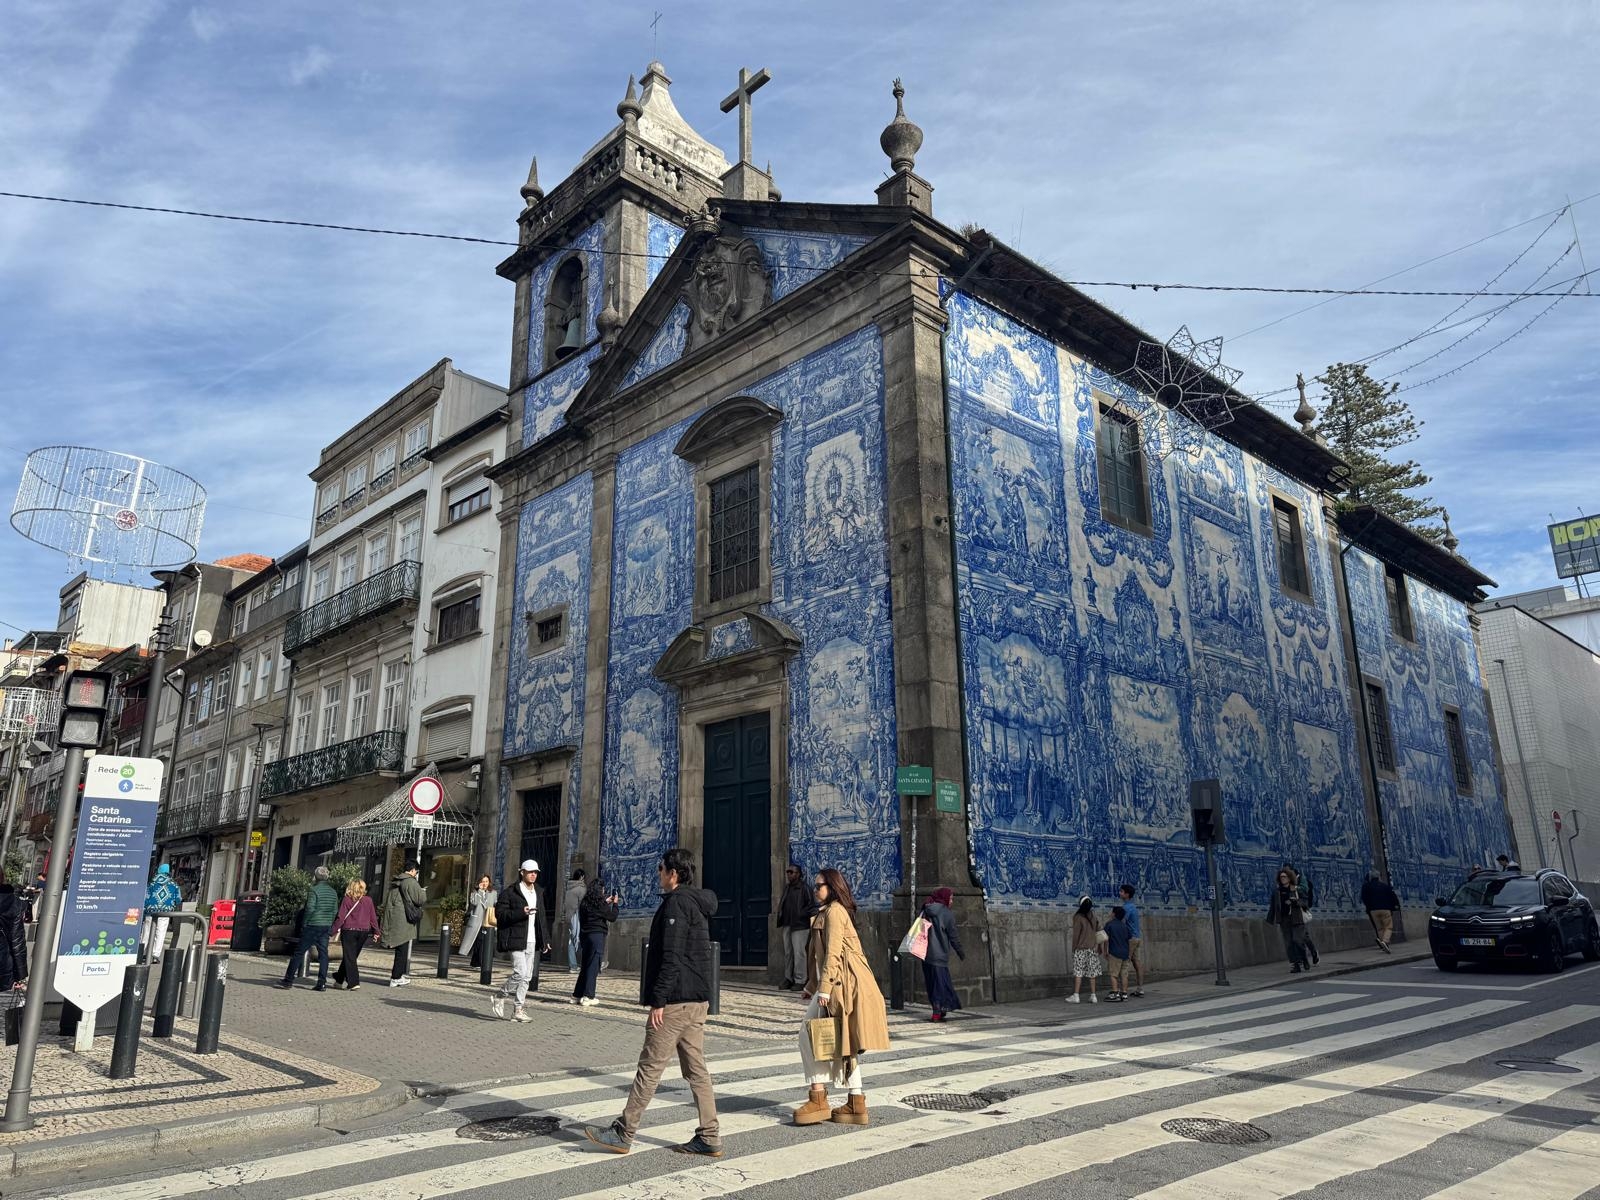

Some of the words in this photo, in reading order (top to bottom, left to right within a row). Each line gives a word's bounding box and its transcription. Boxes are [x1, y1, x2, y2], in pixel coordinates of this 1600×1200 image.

[98, 766, 119, 774] Rede
[91, 805, 120, 815] Santa
[90, 814, 132, 824] Catarina
